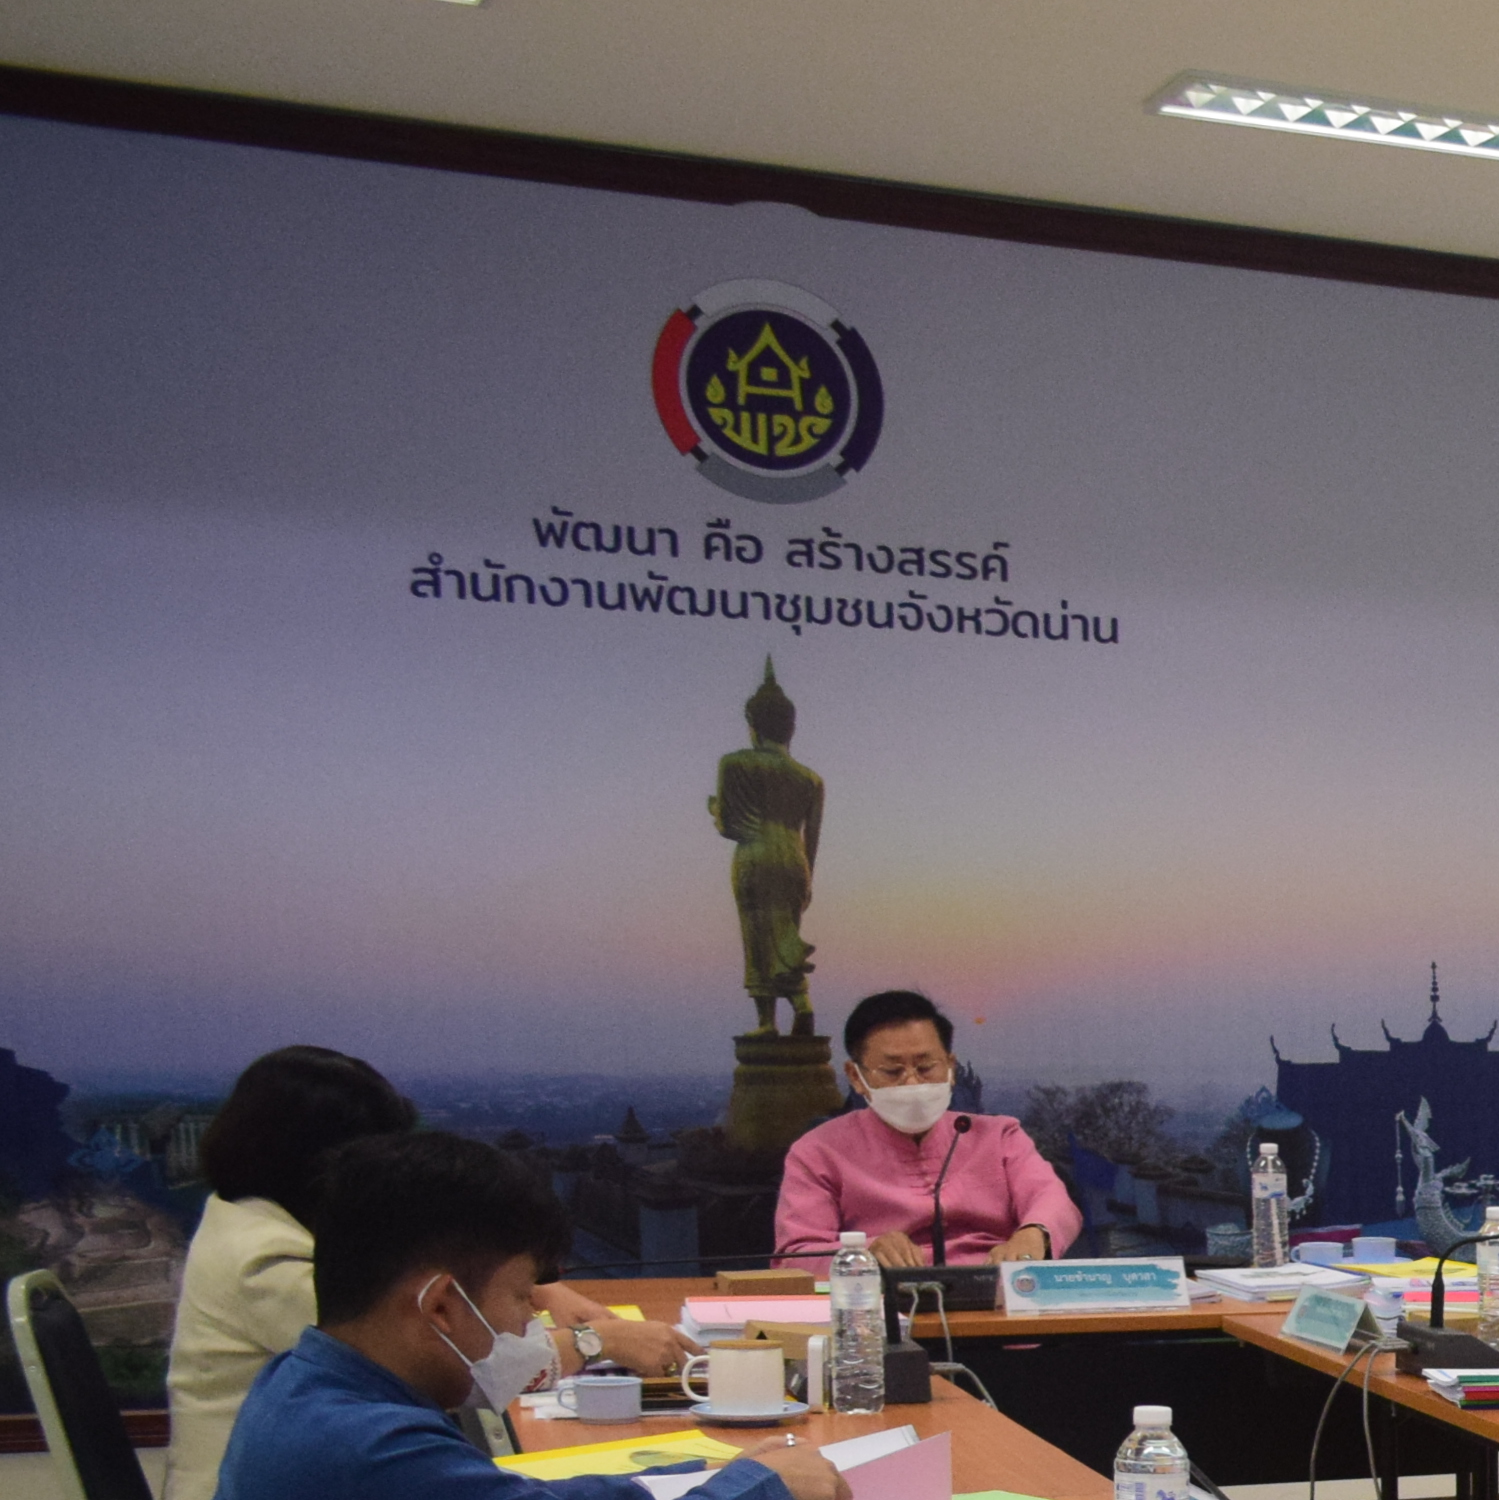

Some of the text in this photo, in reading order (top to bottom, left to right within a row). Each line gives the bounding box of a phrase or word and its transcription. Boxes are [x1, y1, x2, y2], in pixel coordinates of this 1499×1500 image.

[533, 506, 1010, 583] พัฒนา คือ สร้างสรรค์
[409, 553, 1120, 645] สำนักงานพัฒนาชุมชนจังหวัดน่าน
